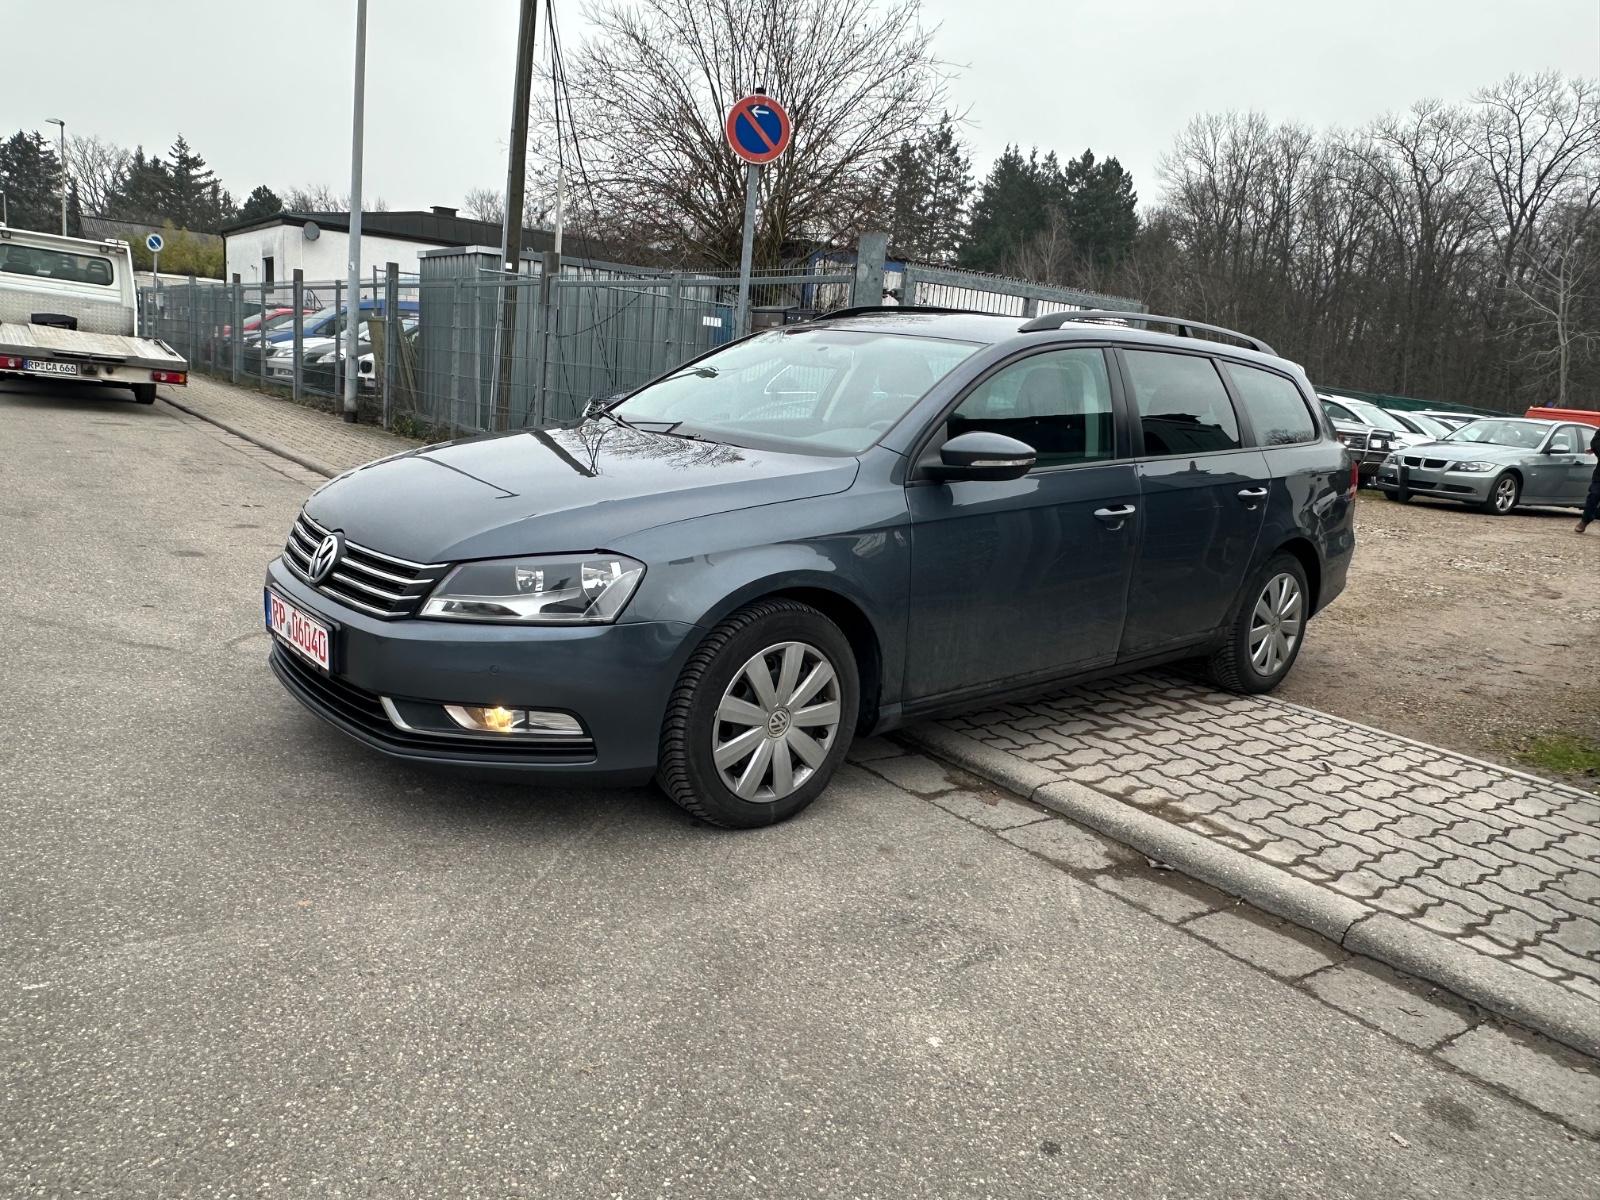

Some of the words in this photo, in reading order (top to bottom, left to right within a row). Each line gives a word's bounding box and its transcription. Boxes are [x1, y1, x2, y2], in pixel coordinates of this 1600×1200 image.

[28, 360, 40, 370] RP
[45, 362, 58, 372] CA
[59, 364, 76, 373] 666
[272, 598, 286, 631] RP
[292, 610, 326, 663] 06040
